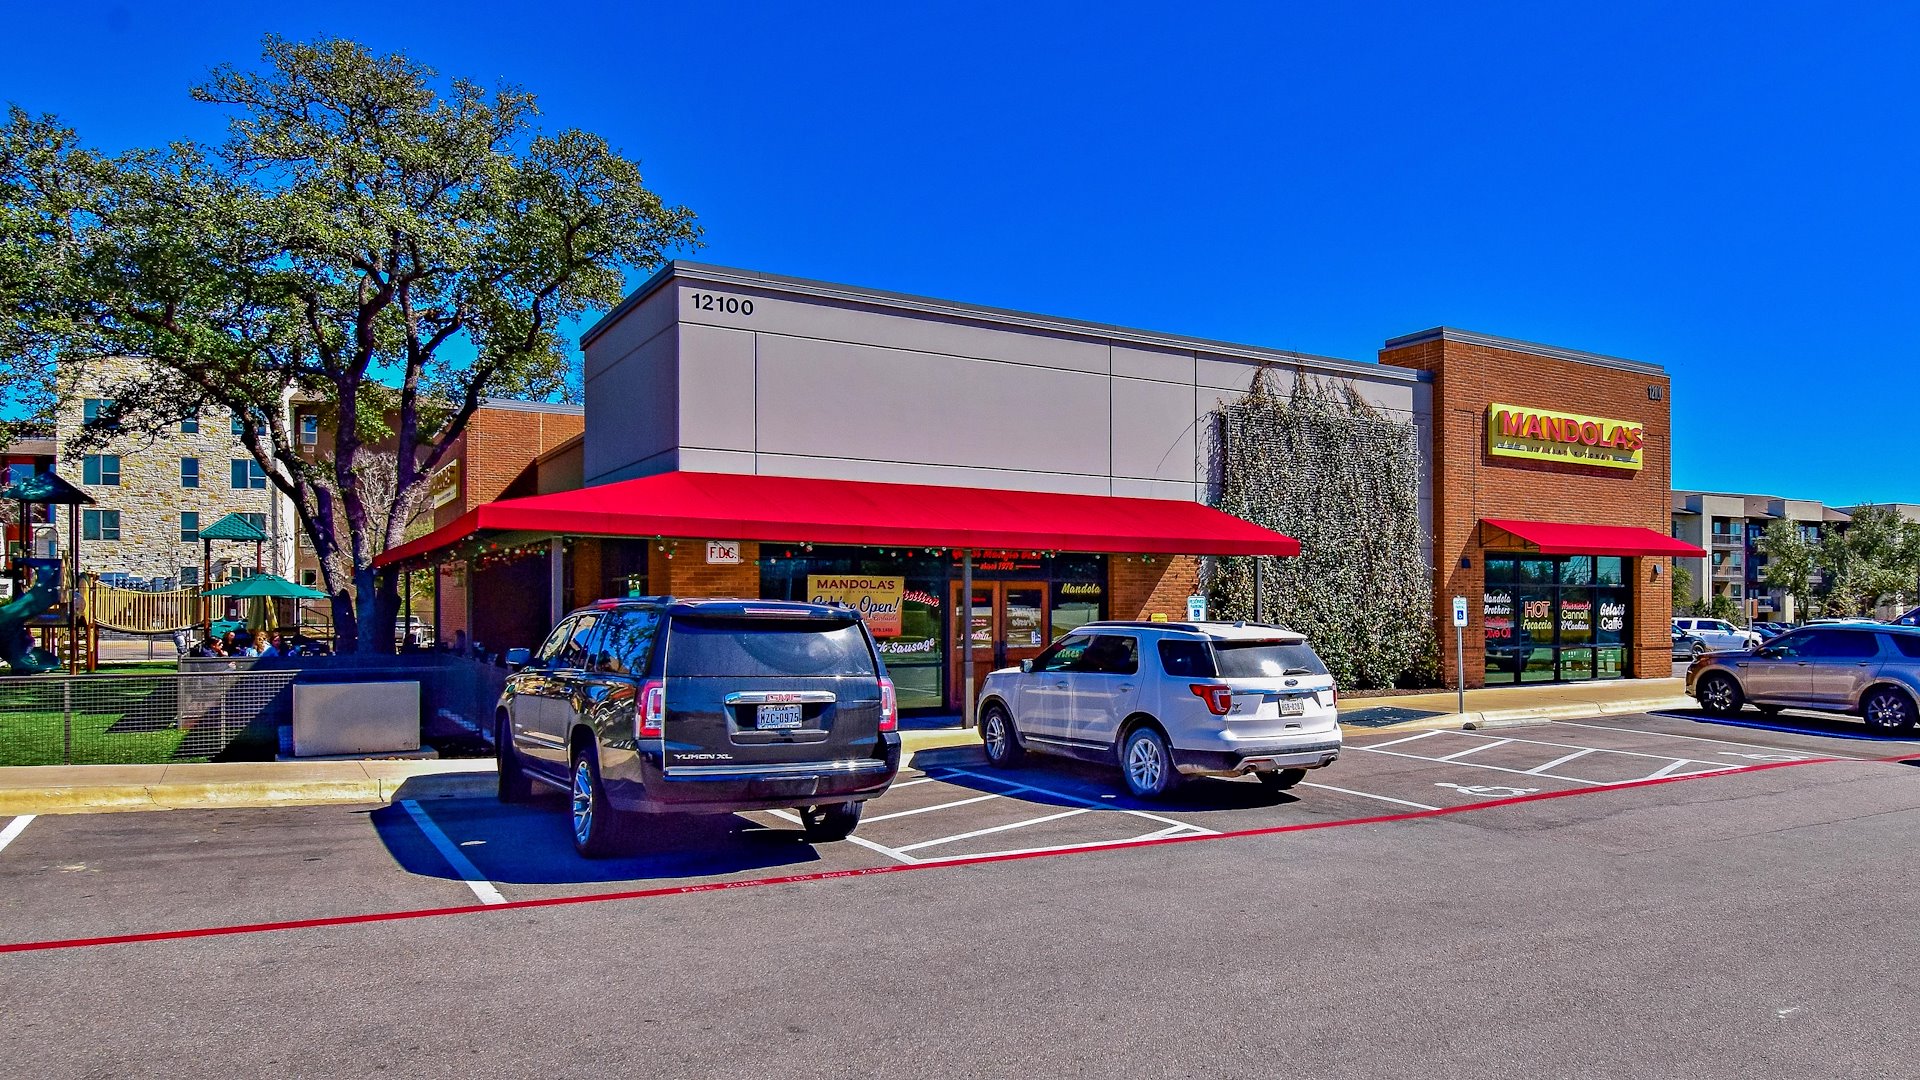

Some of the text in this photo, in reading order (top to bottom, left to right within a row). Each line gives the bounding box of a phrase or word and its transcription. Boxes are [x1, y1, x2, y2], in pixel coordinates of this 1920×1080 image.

[691, 293, 754, 316] 12100
[1498, 410, 1643, 451] MANDOLA'S
[710, 546, 737, 559] F.D.C.
[816, 579, 895, 590] MANDOLA'S
[1061, 583, 1102, 594] Mandola
[859, 595, 901, 619] Open!
[1484, 605, 1510, 615] Brothers
[1524, 601, 1551, 618] HOT
[1600, 602, 1625, 616] Gelati
[1561, 609, 1588, 619] Cannoli
[1522, 619, 1552, 630] Focaccia
[891, 637, 935, 654] Sausage
[766, 694, 801, 702] GMC
